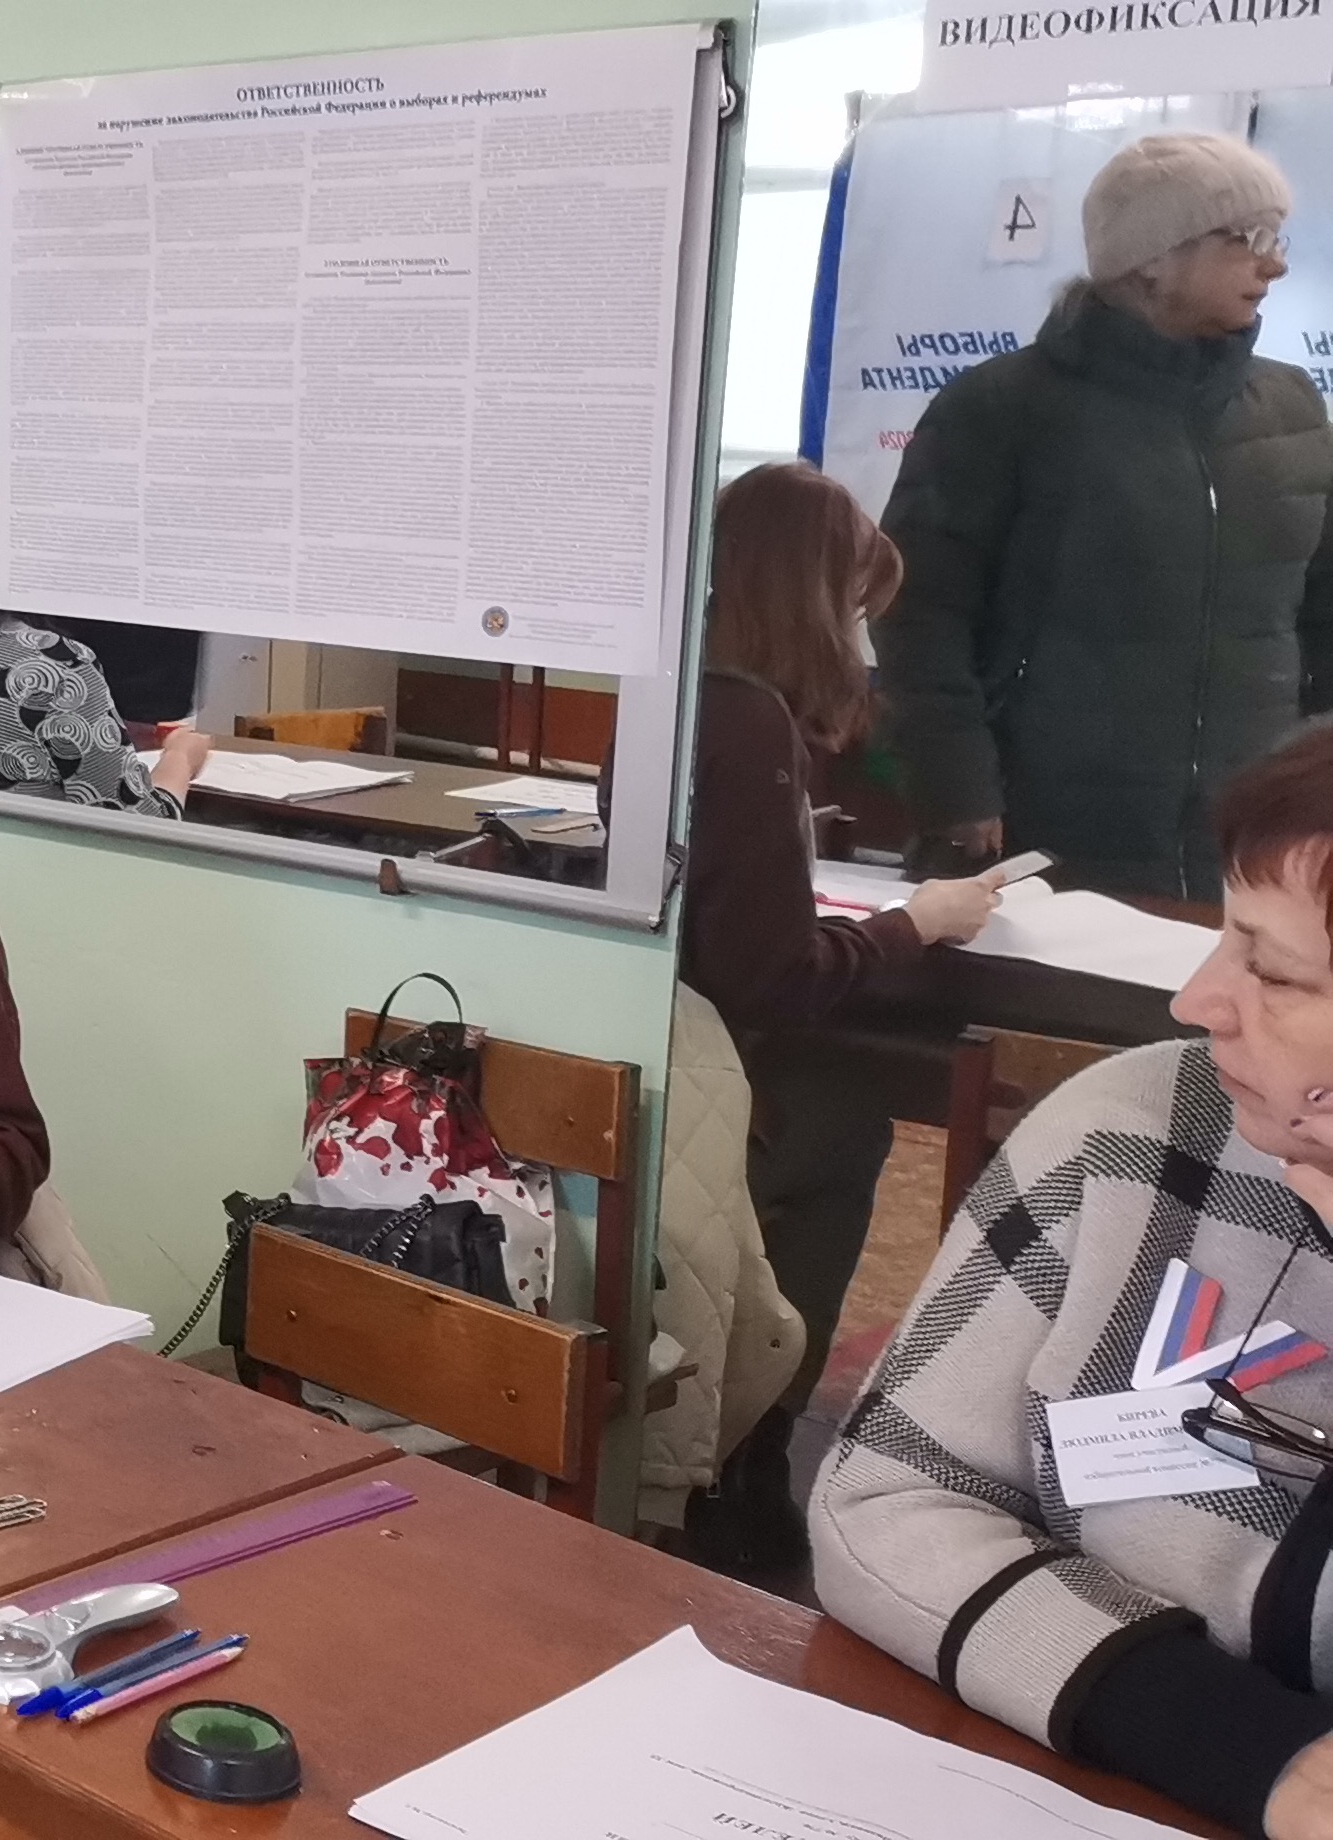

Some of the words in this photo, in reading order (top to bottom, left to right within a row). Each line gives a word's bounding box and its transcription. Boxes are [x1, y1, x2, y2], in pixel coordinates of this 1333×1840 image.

[236, 77, 385, 103] ОТВЕТСТВЕННОСТЬ
[260, 101, 322, 120] Российской
[324, 98, 387, 116] Федерации
[399, 92, 449, 111] выборах
[461, 86, 548, 108] референдумах
